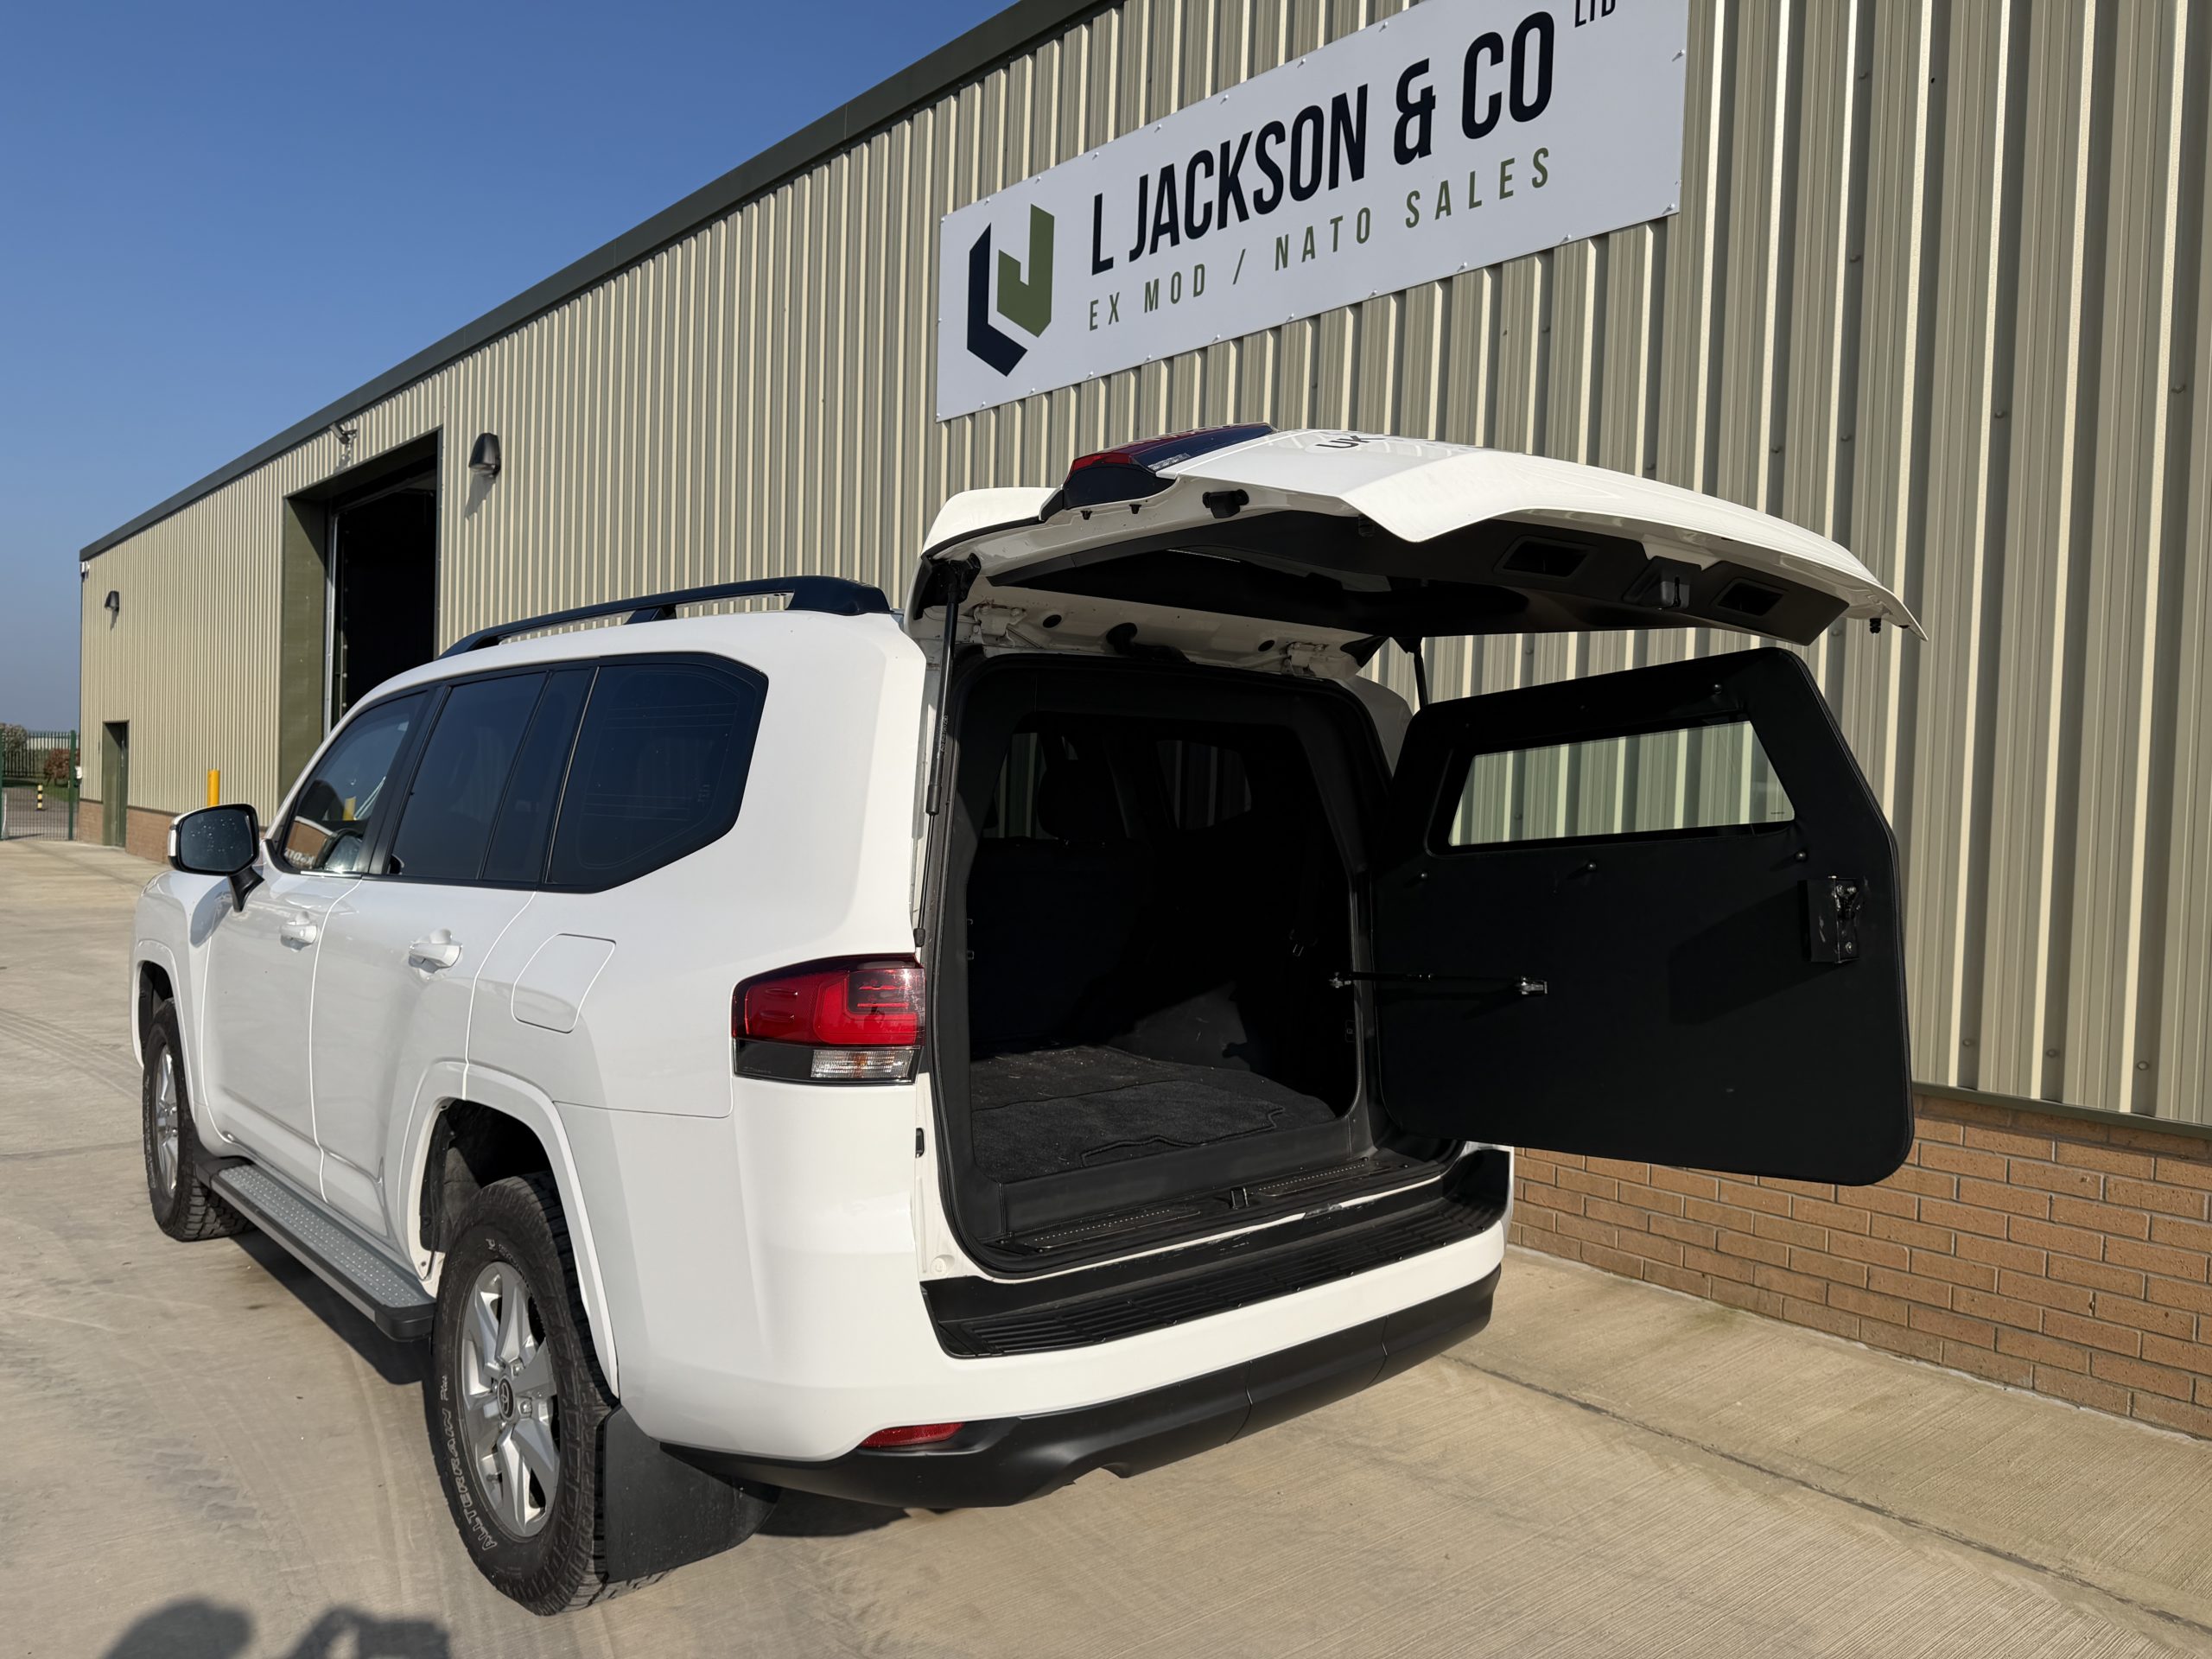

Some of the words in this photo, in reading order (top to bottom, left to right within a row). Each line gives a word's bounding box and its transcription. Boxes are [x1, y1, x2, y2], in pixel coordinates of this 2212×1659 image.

[1091, 193, 1115, 276] L
[1128, 83, 1370, 263] JACKSON
[1393, 57, 1438, 166] &
[1461, 10, 1555, 140] CO
[1089, 291, 1121, 332] EX
[1144, 264, 1206, 314] MOD
[1274, 207, 1371, 271] NATO
[1405, 147, 1549, 229] SALES
[1315, 435, 1386, 448] UK
